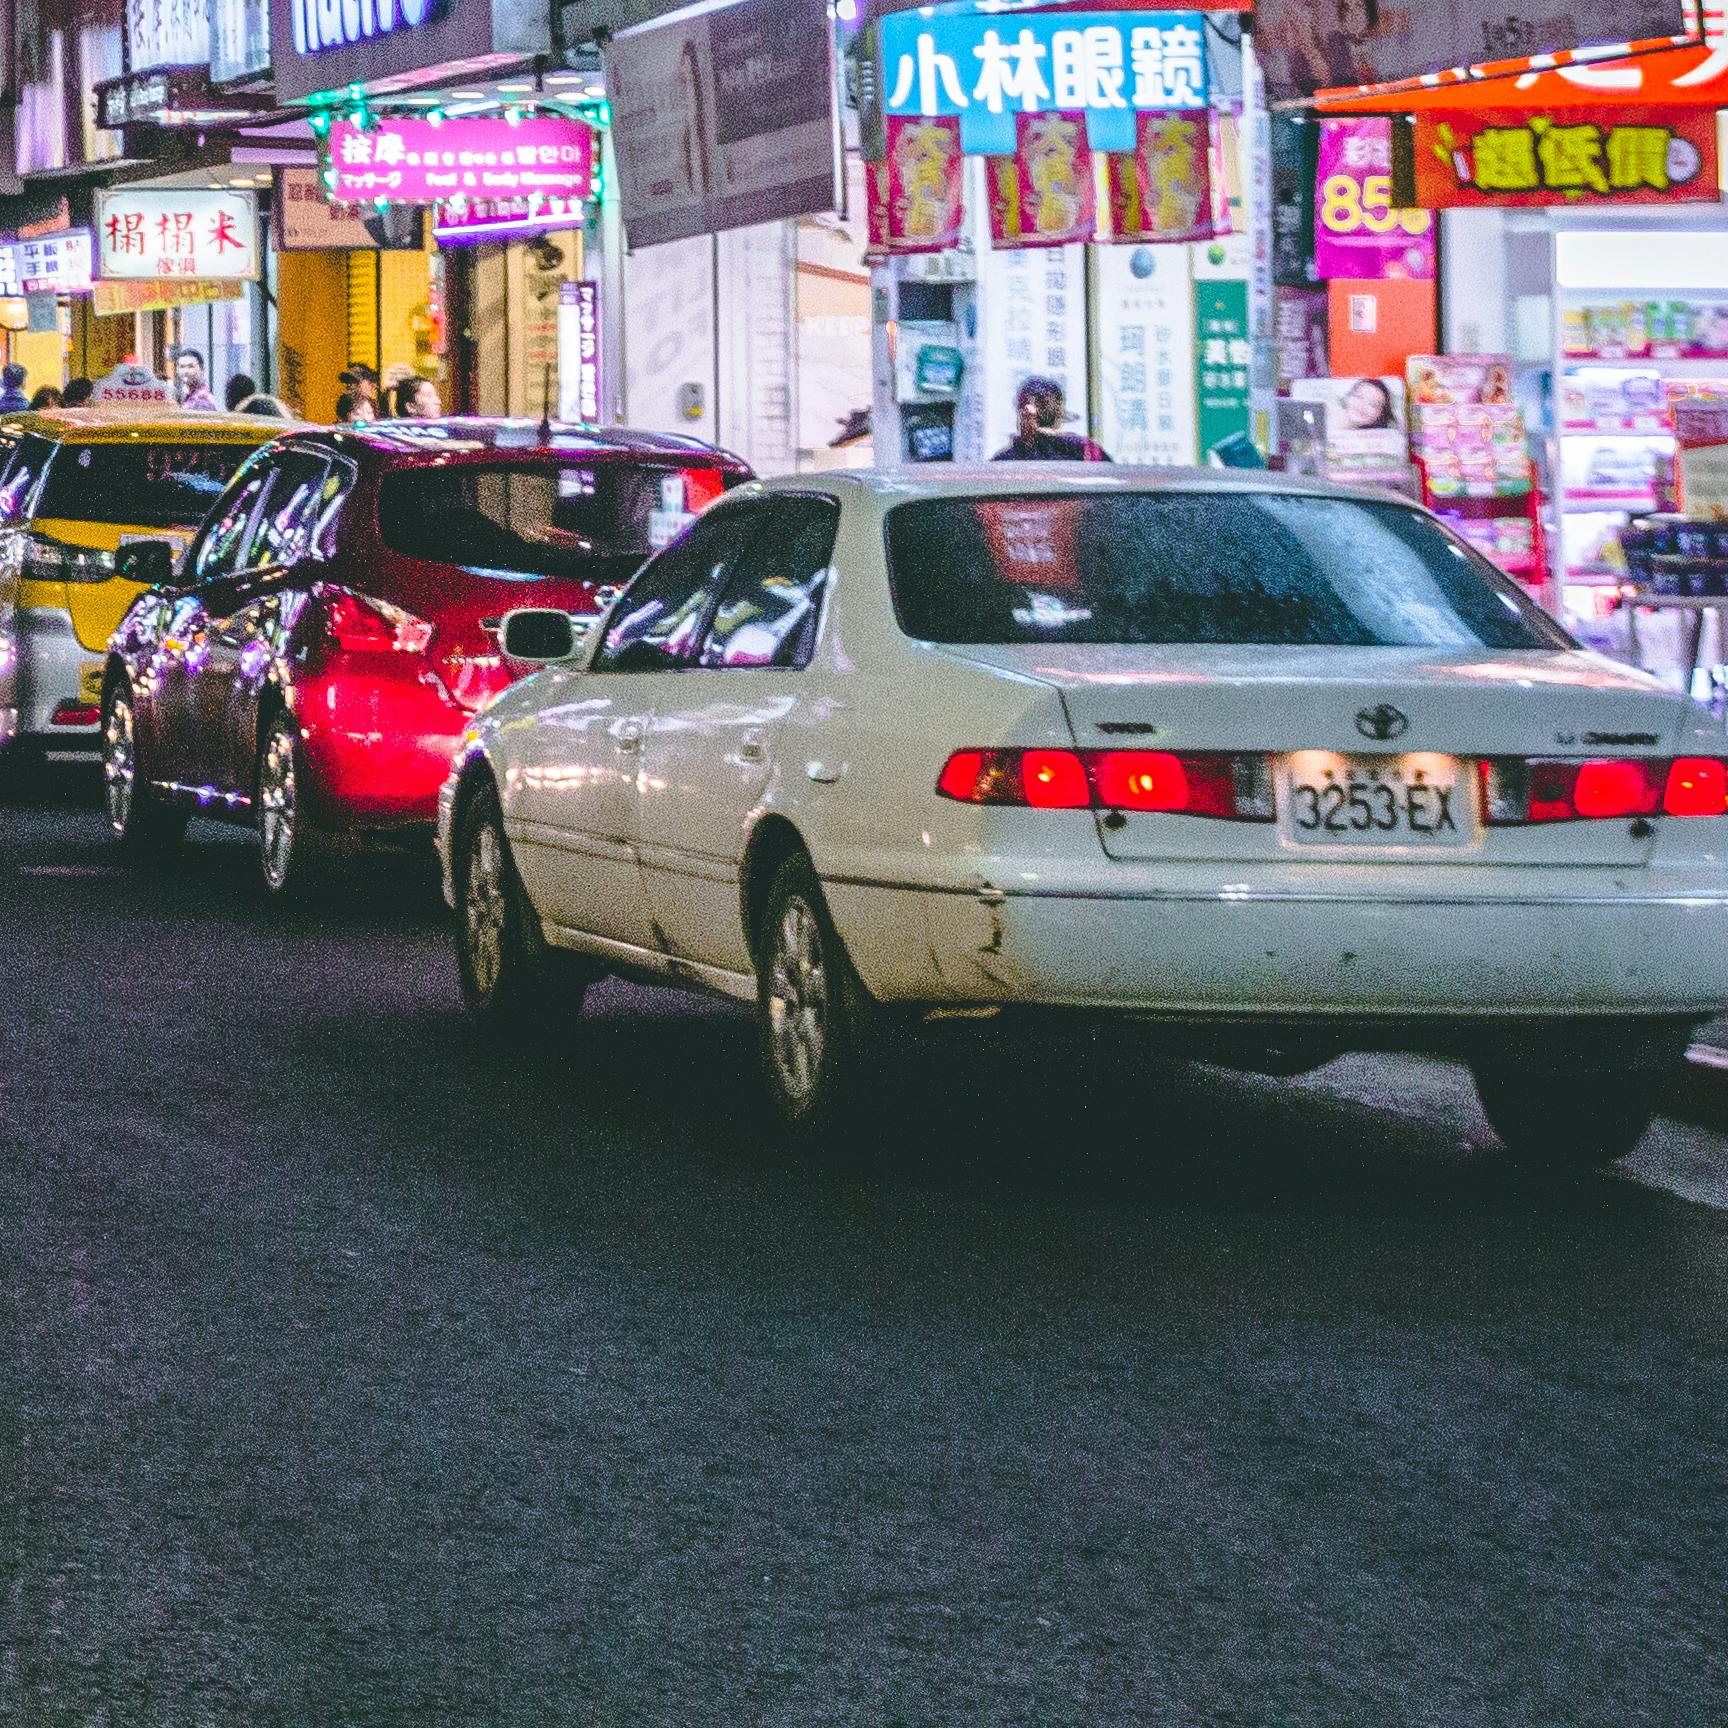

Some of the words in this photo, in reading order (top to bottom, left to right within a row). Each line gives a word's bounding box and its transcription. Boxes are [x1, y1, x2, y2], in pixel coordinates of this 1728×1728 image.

[888, 24, 1205, 115] 小林眼鏡
[102, 388, 166, 402] 55688
